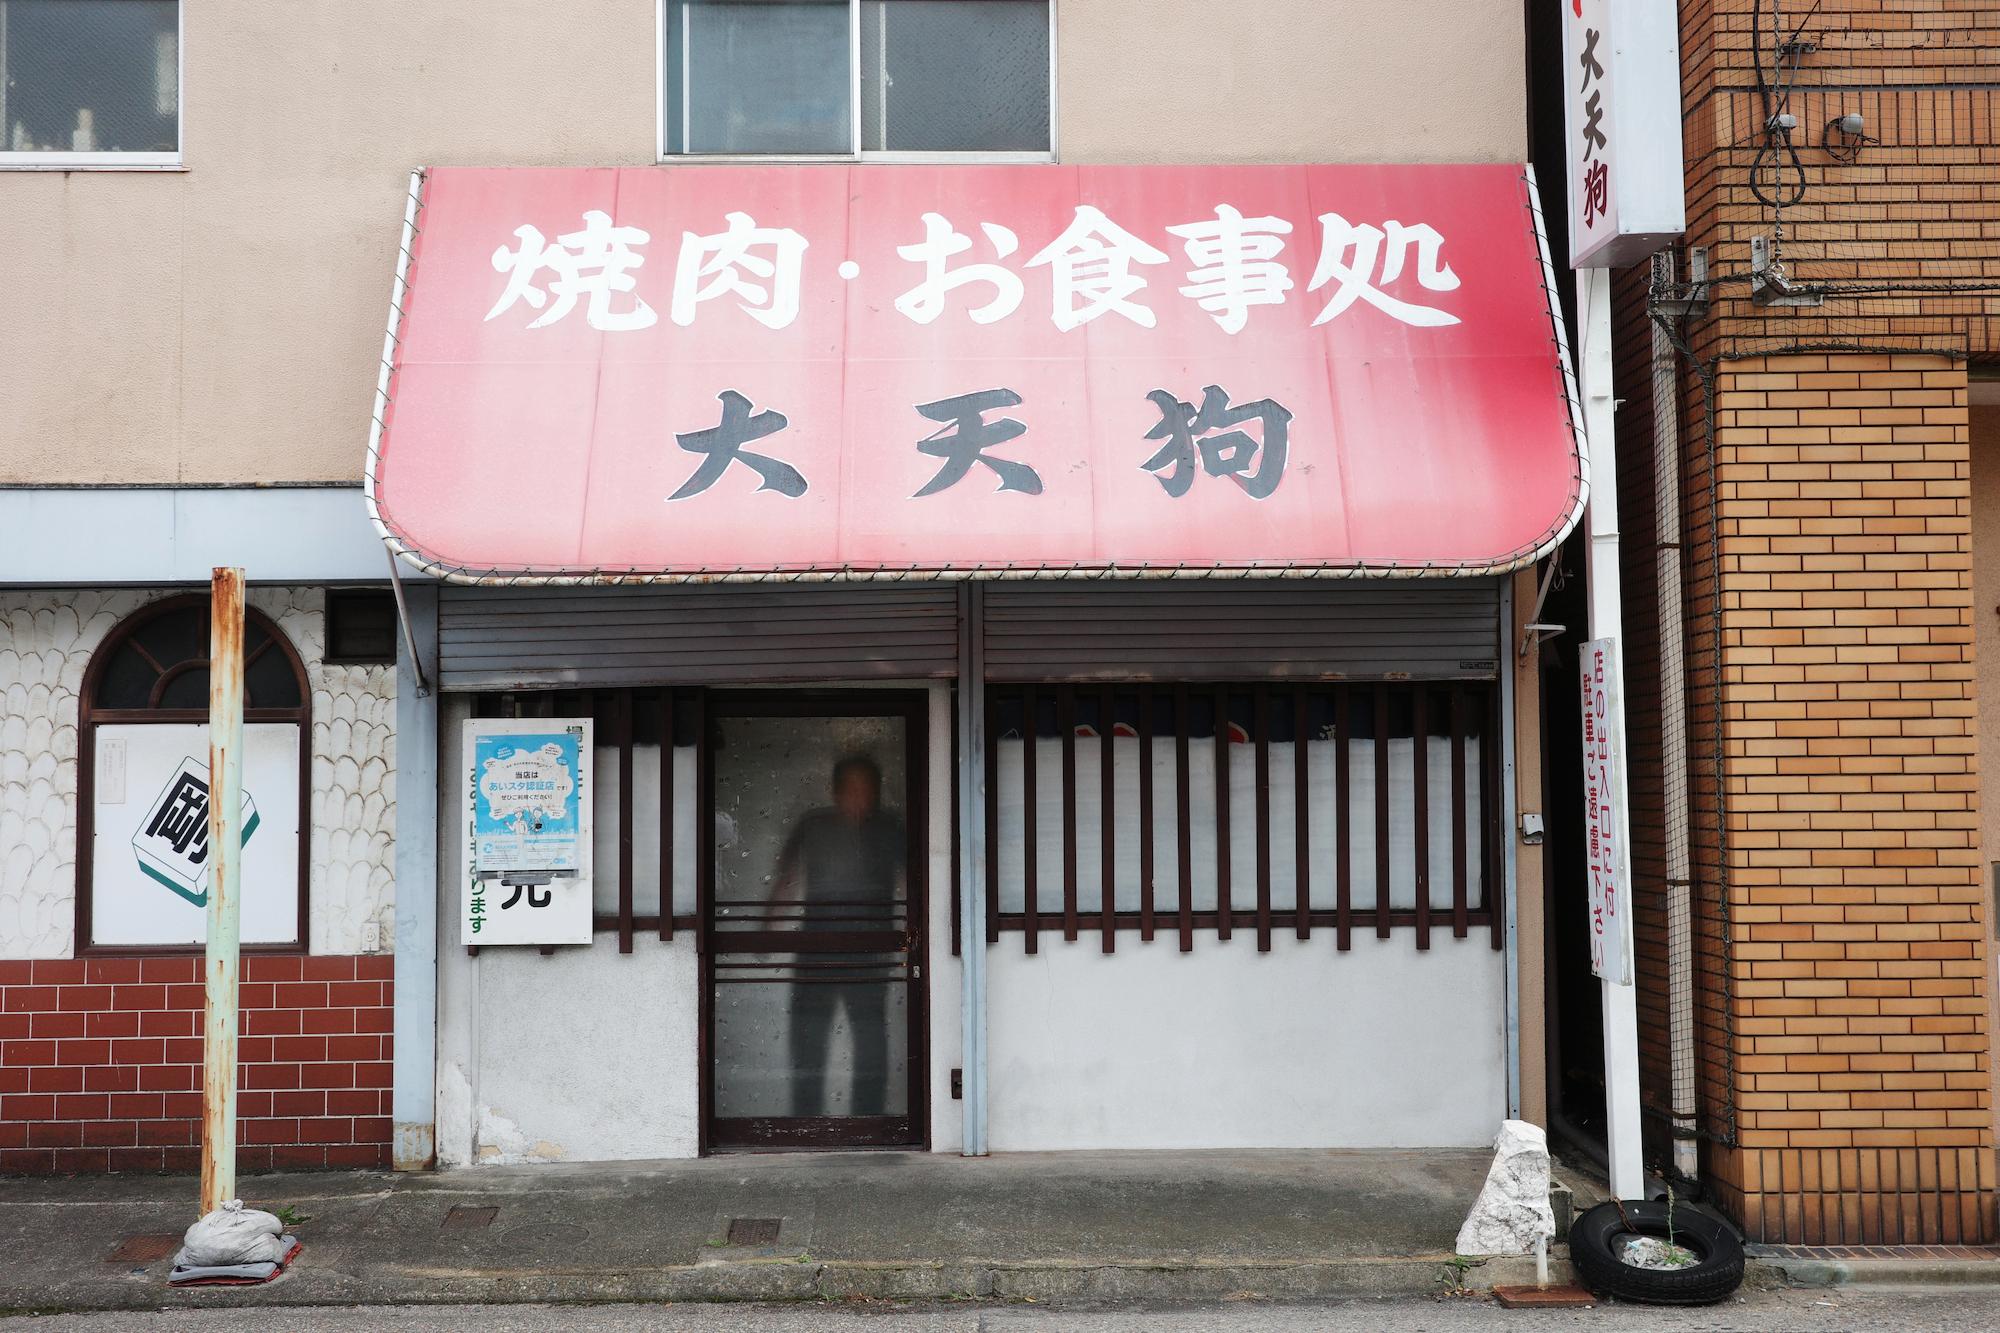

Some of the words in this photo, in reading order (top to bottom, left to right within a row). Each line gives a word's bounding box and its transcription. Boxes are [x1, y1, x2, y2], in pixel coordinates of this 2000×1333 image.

[1580, 28, 1608, 229] 大天狗
[483, 203, 1462, 335] 焼肉・お食事処
[664, 384, 1294, 502] 大天狗
[515, 771, 539, 779] 当店は
